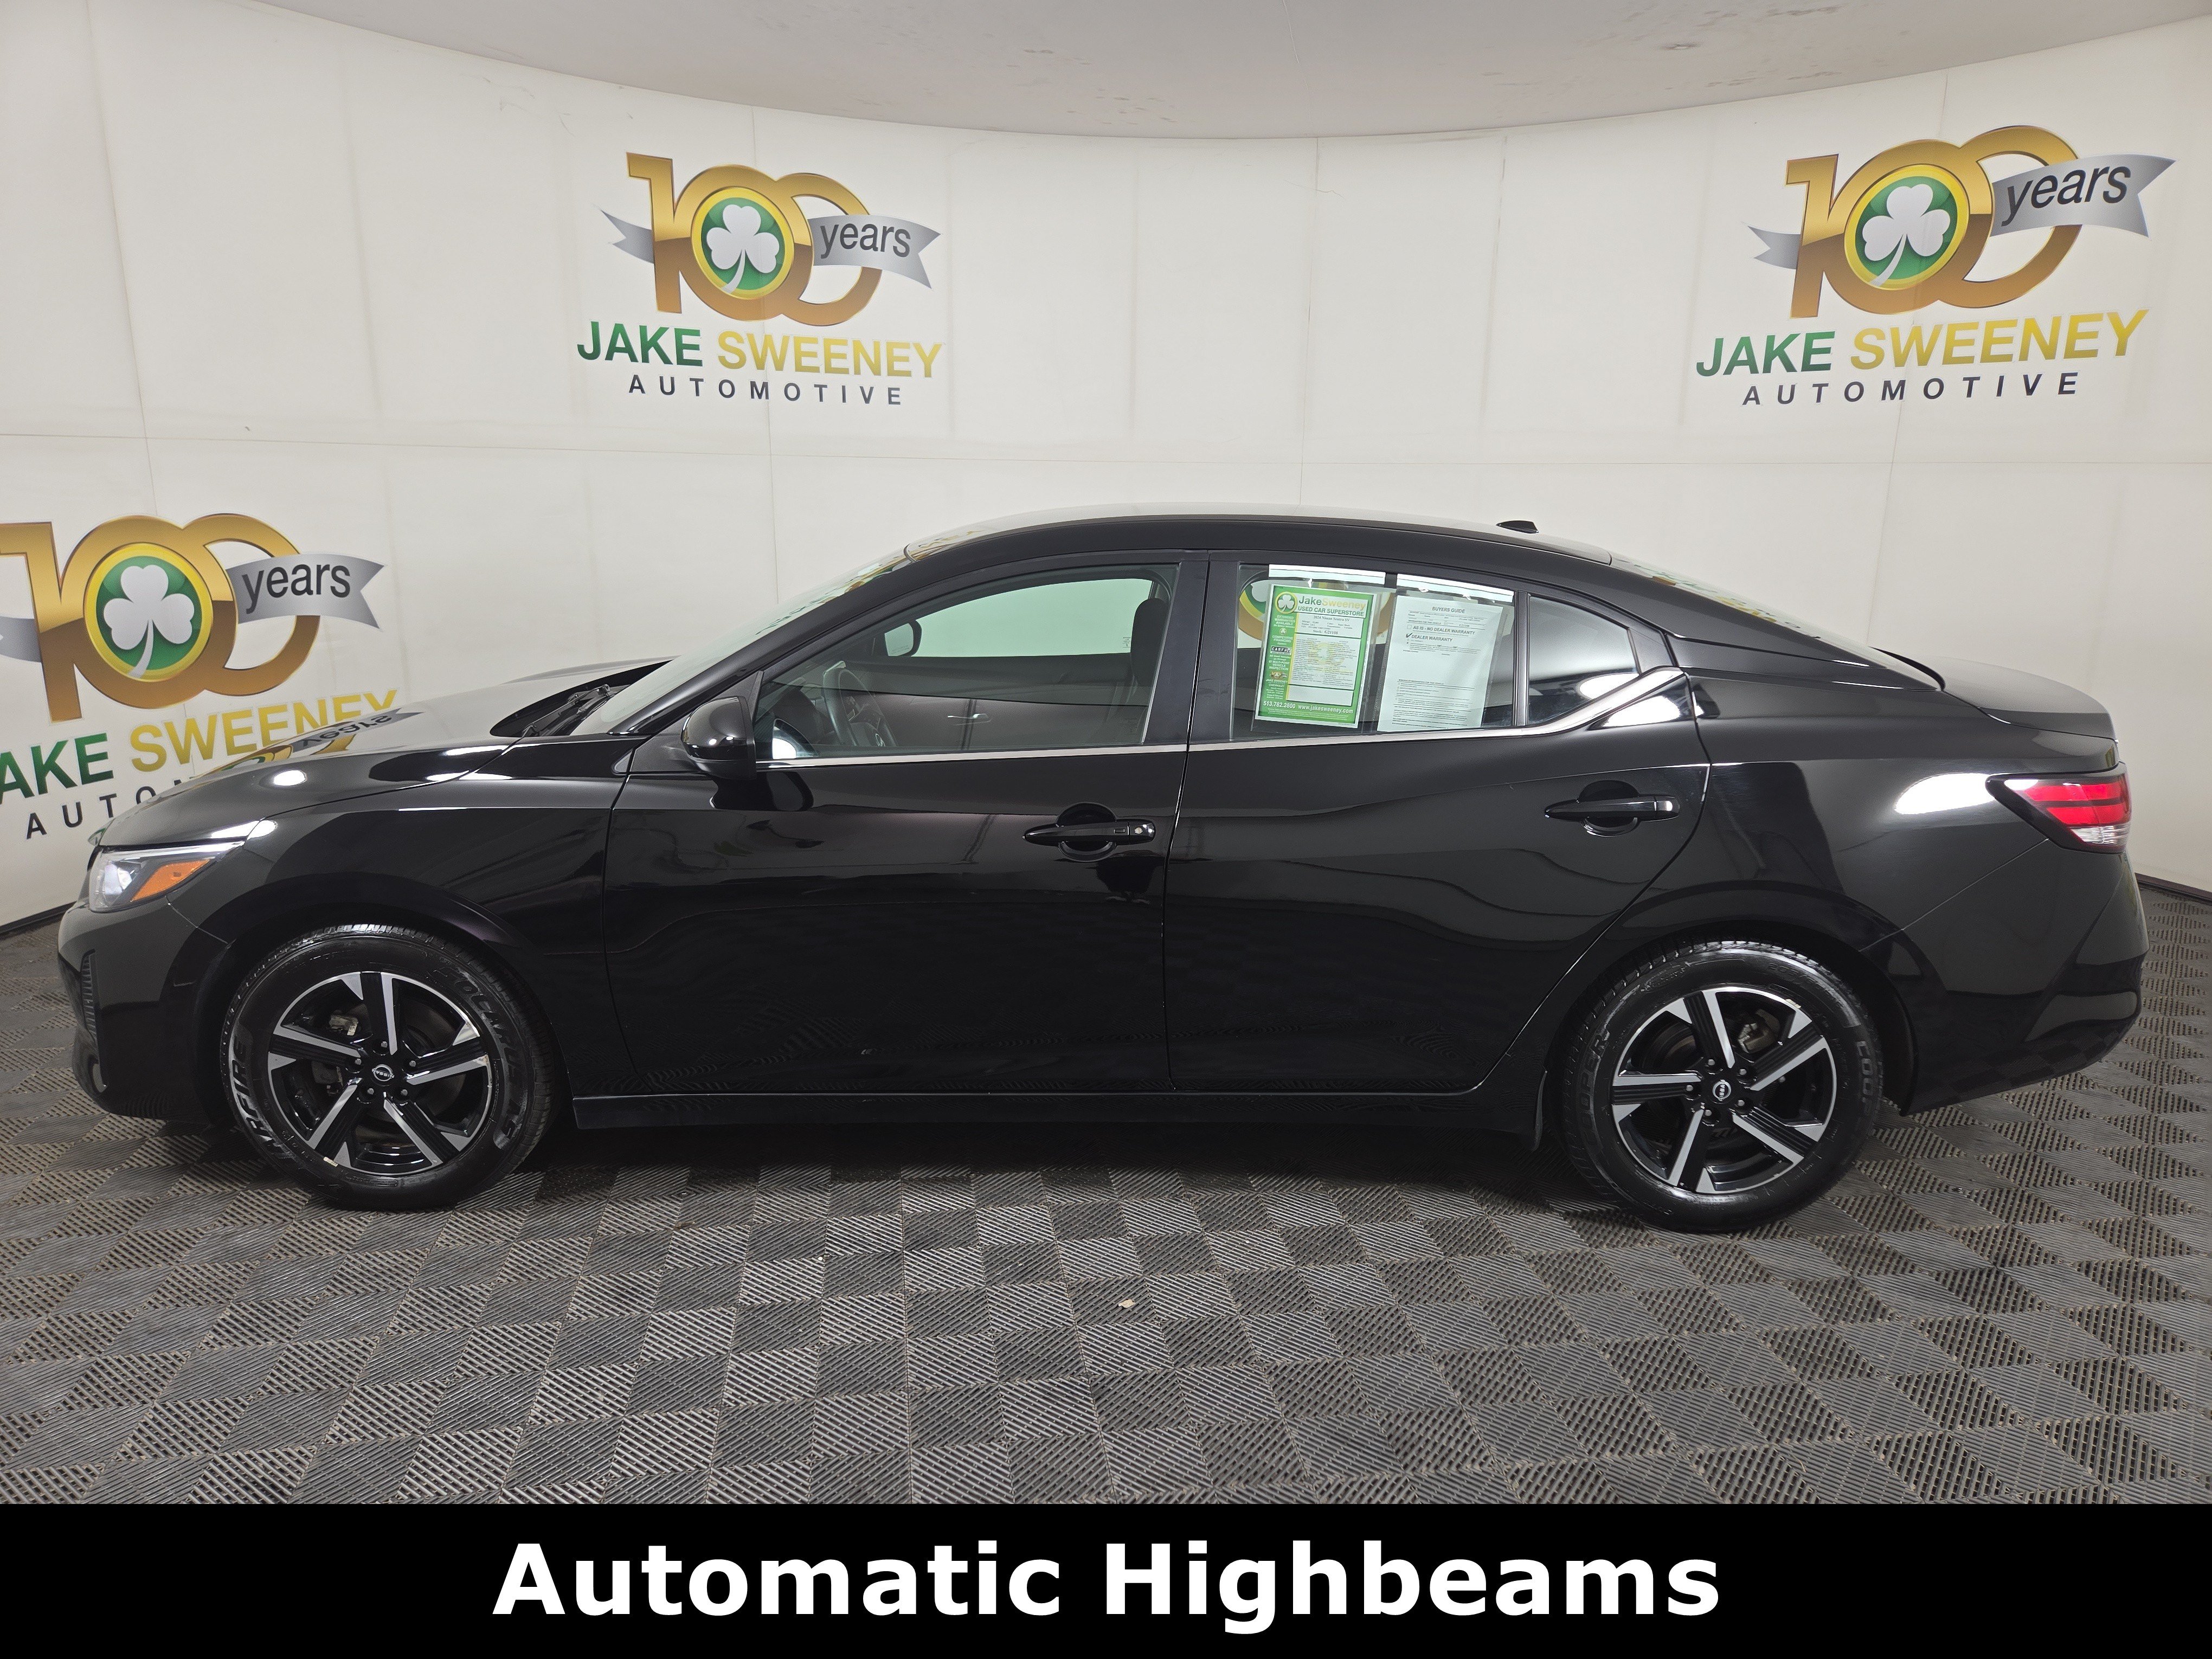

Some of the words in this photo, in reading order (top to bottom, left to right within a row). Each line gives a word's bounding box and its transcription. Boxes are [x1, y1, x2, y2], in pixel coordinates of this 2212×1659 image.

[626, 151, 882, 326] 100
[820, 223, 910, 259] years
[1785, 125, 2084, 319] 100
[2001, 165, 2131, 227] years
[577, 321, 703, 367] JAKE
[717, 331, 943, 378] SWEENEY
[1696, 331, 1836, 377] JAKE
[1850, 309, 2150, 370] SWEENEY
[628, 375, 901, 406] AUTOMOTIVE
[1742, 372, 2079, 406] AUTOMOTIVE
[242, 564, 351, 614] years
[1327, 608, 1365, 616] SUPERSTORE
[1297, 704, 1353, 714] www.jakesweeney.com
[0, 732, 114, 805] AKE
